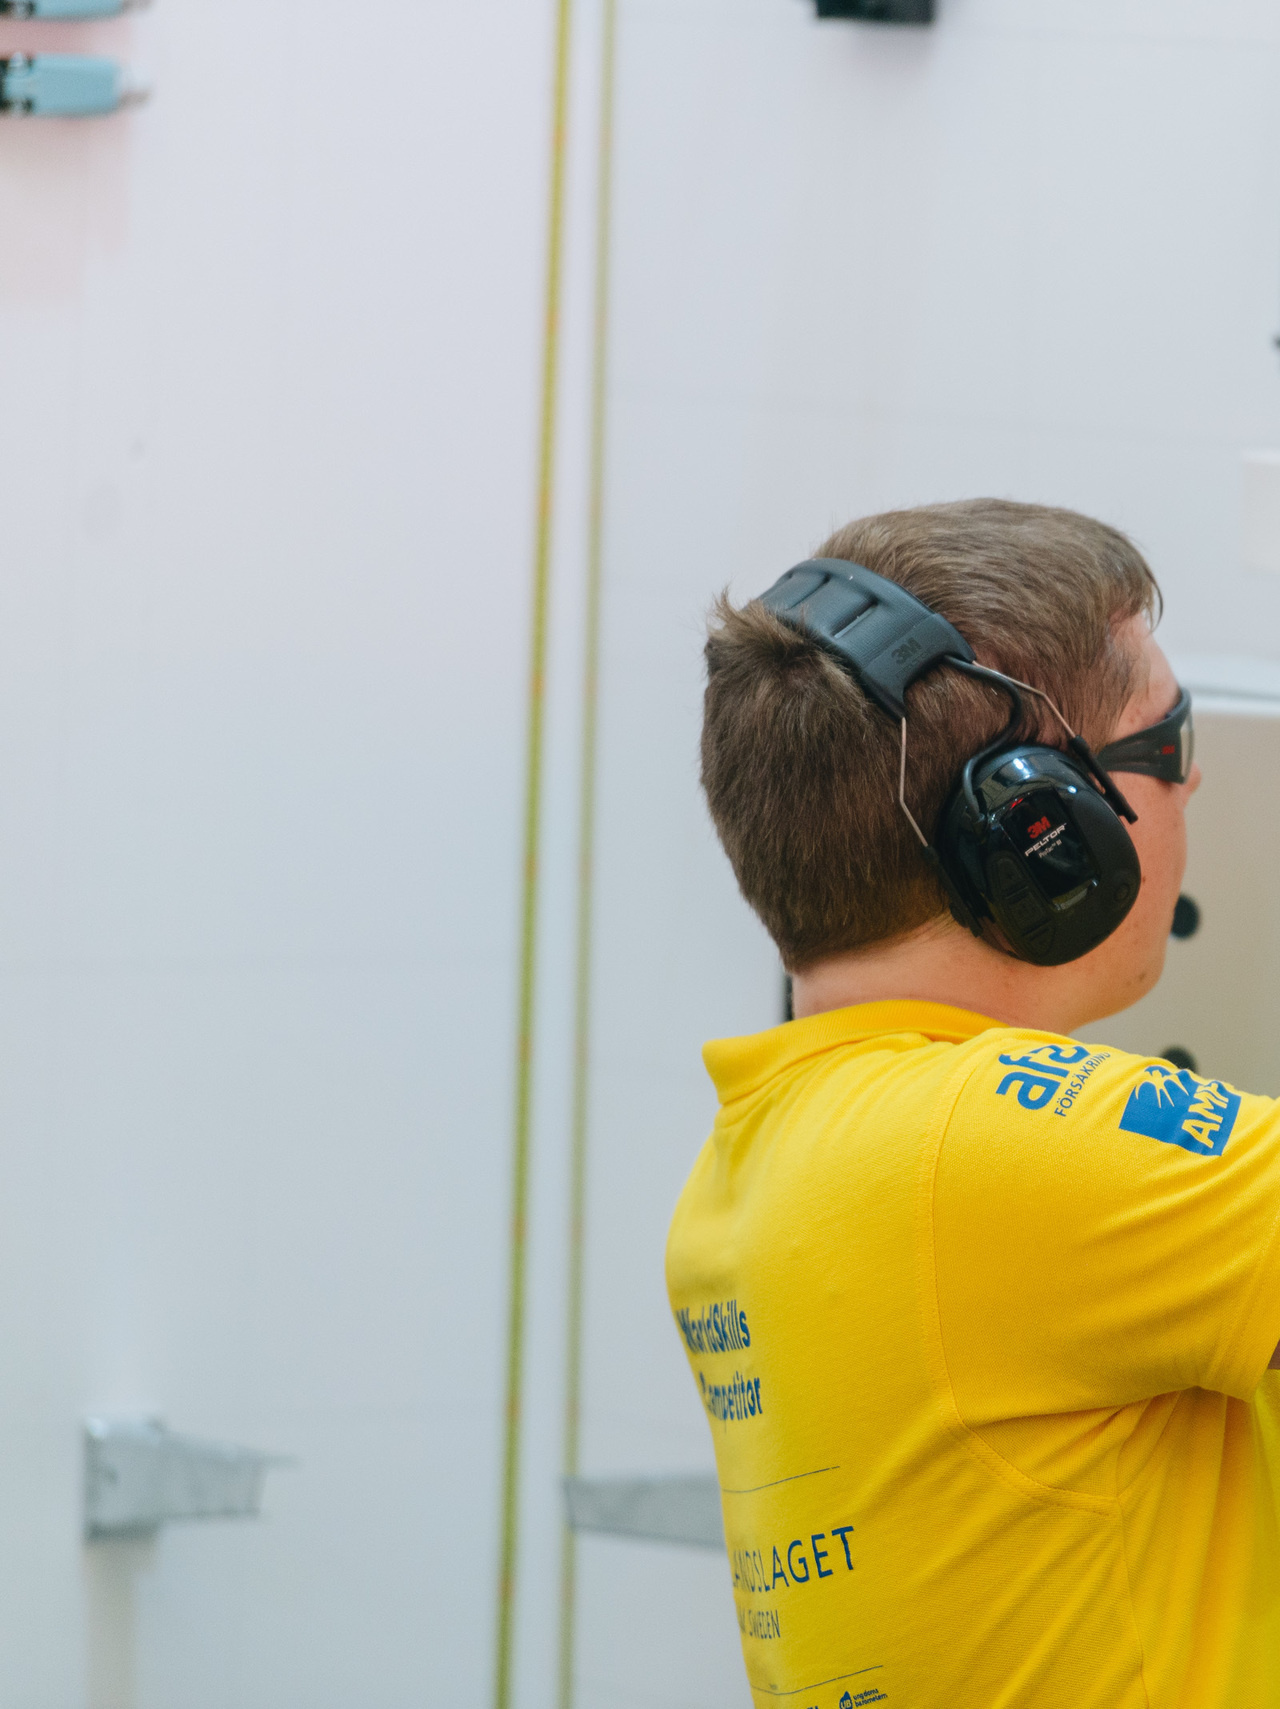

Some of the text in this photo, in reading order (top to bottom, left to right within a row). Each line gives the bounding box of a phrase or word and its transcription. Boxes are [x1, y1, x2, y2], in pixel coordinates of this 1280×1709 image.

[1024, 825, 1066, 857] PELTOR
[1027, 815, 1051, 839] 3M
[675, 1299, 751, 1356] WorldSkills
[748, 1608, 781, 1640] SWEDEN
